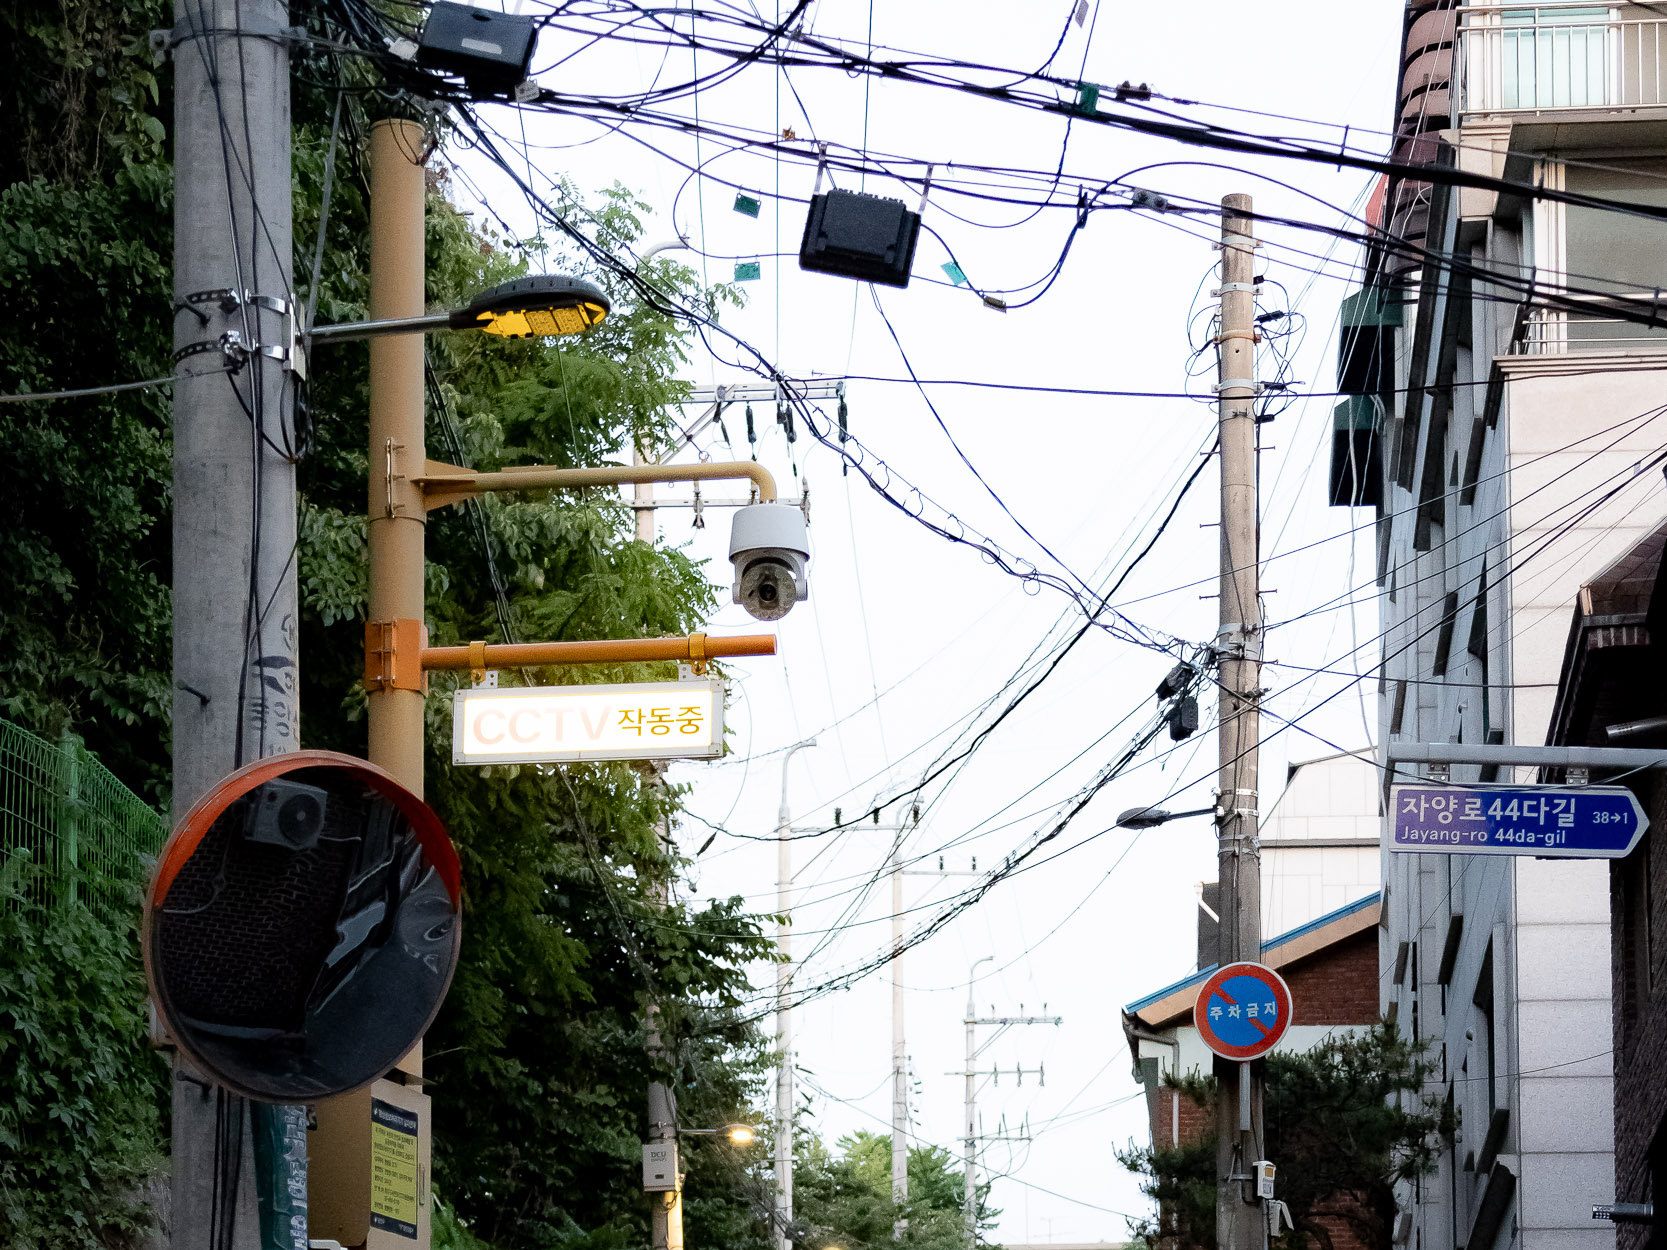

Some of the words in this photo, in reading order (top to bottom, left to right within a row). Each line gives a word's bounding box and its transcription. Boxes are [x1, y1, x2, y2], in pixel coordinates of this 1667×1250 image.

[473, 705, 611, 745] CCTV
[617, 705, 704, 737] 작동중
[1401, 794, 1575, 828] 자양로44다길
[1401, 825, 1488, 844] Jayang-ro
[1495, 828, 1566, 847] 44da-gil
[1209, 1001, 1276, 1021] 주차금지
